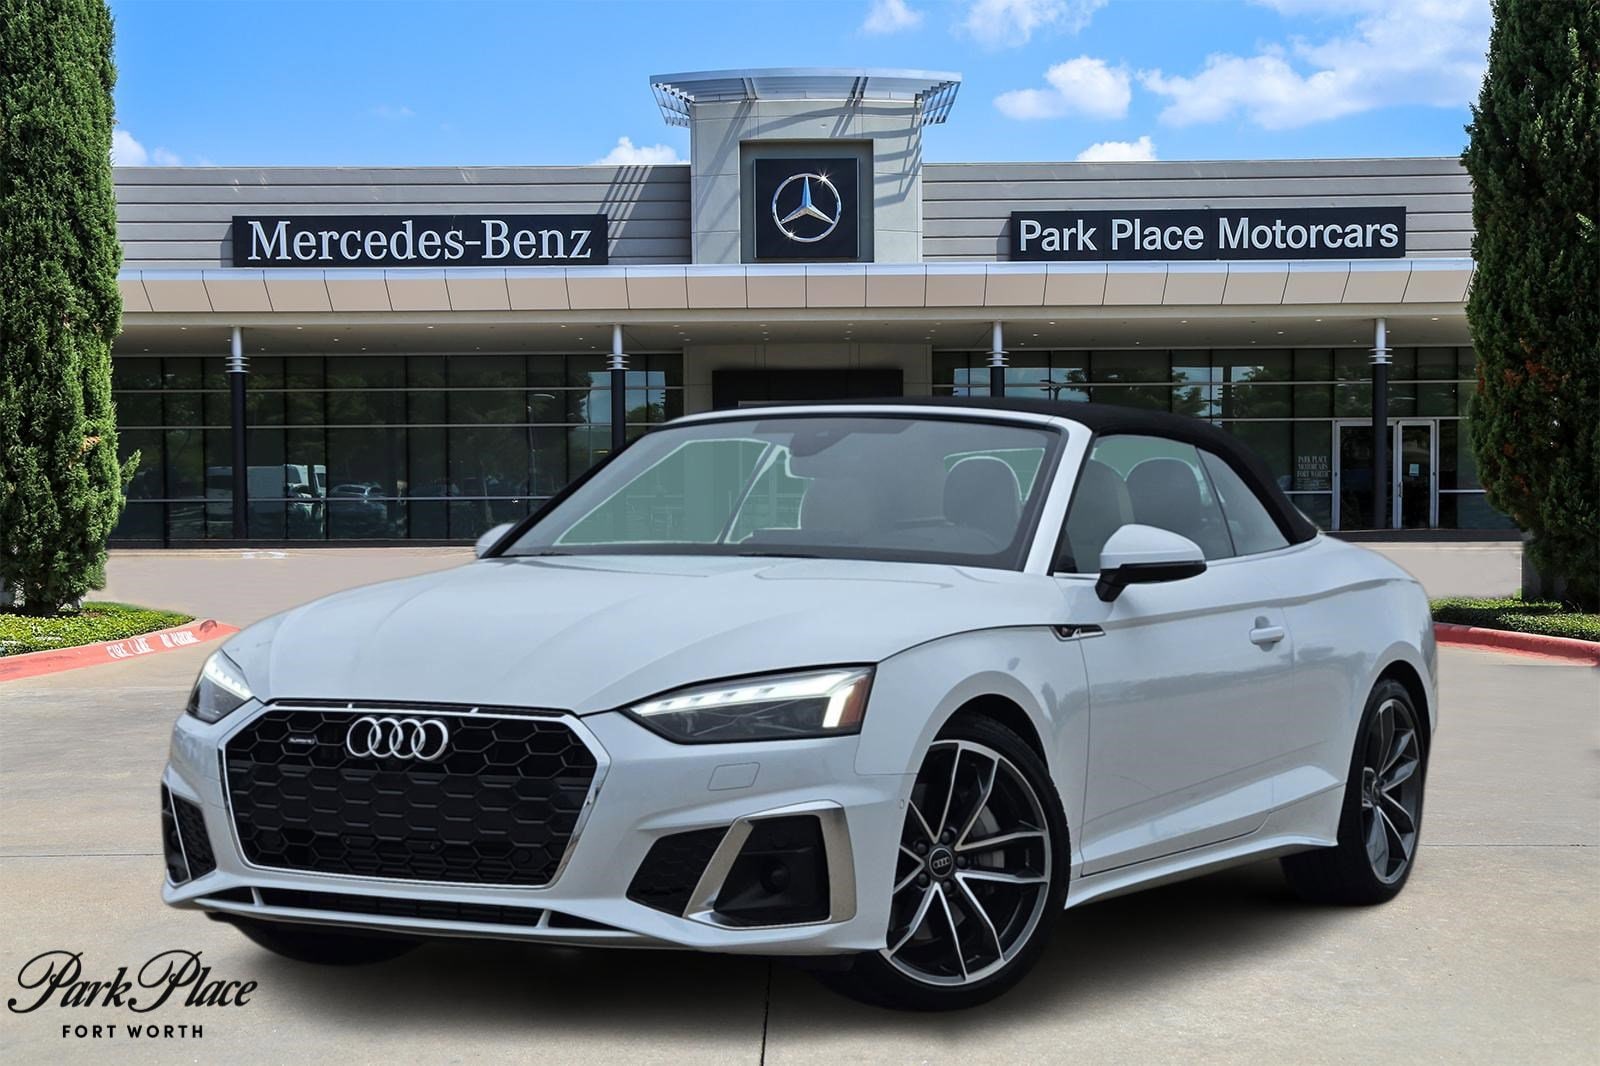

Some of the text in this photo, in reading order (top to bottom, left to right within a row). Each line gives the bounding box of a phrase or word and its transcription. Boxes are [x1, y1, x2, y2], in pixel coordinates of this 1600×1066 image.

[247, 219, 592, 261] Mercedes-Benz
[1019, 216, 1400, 252] Park Place Motorcars
